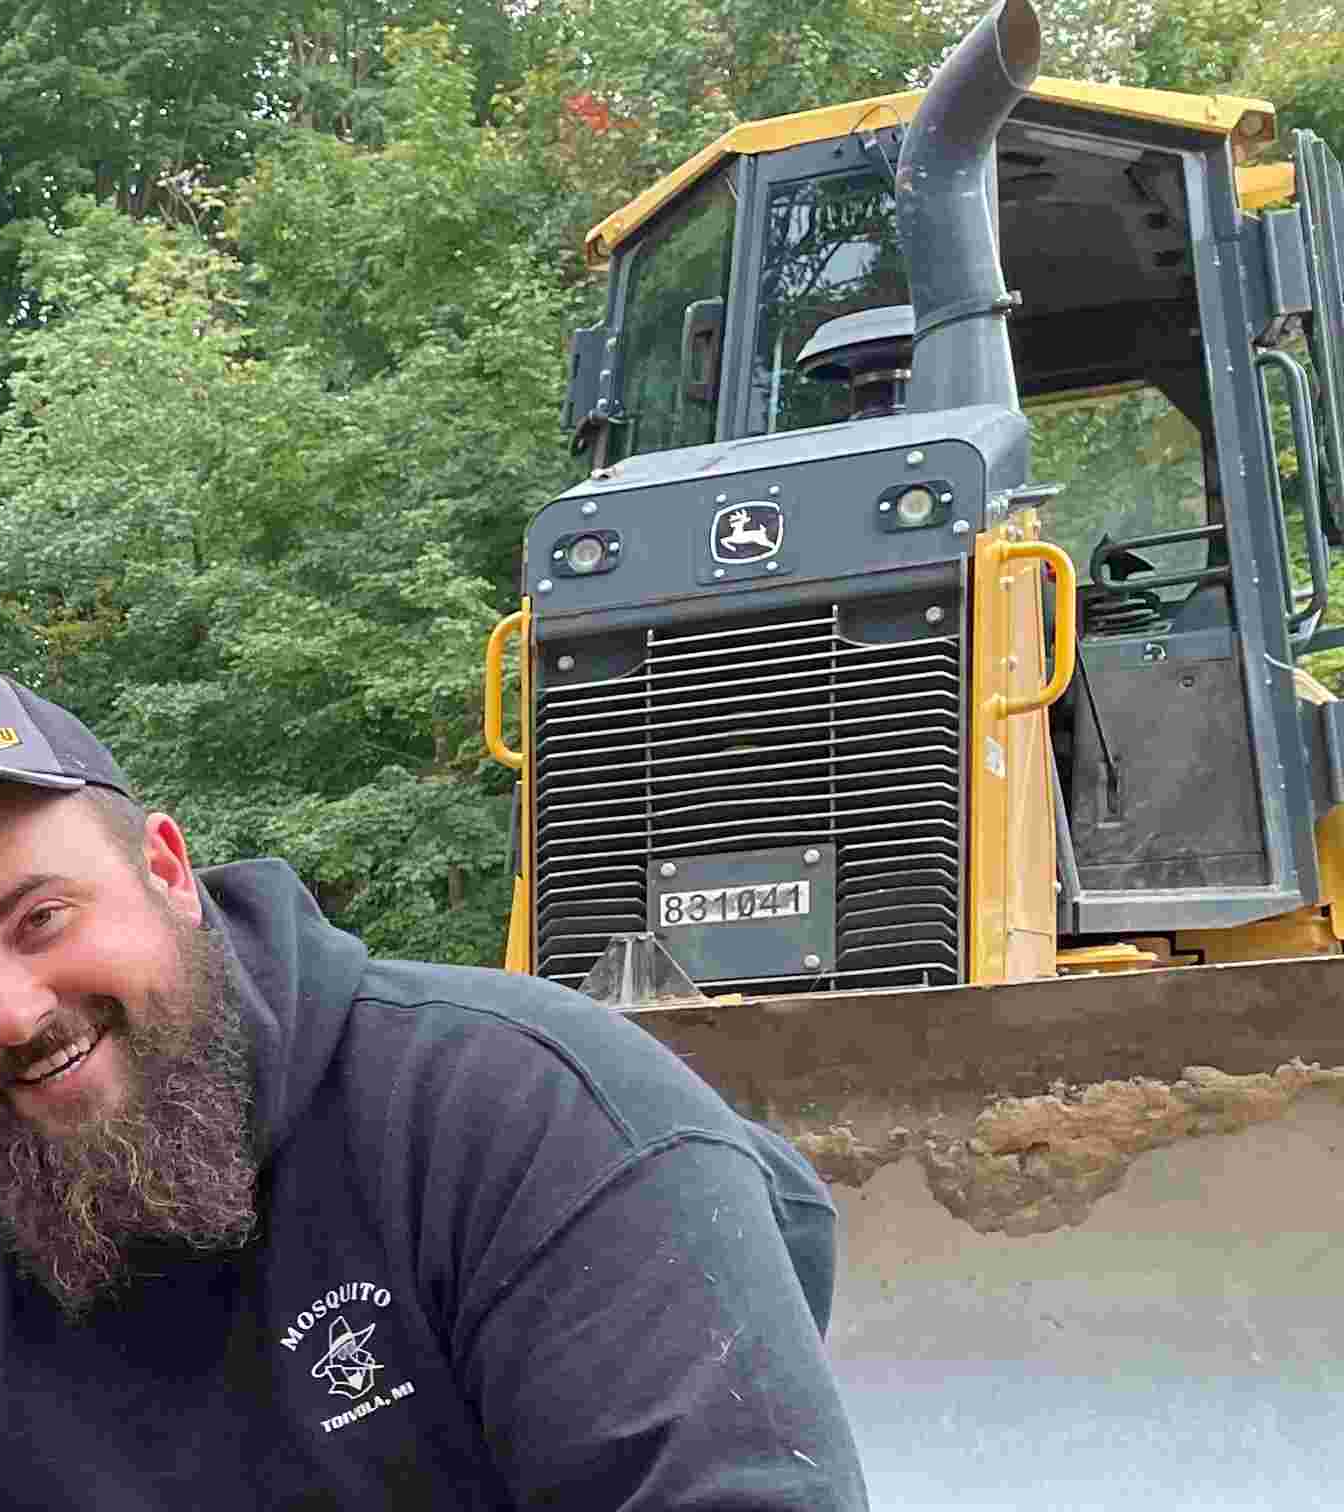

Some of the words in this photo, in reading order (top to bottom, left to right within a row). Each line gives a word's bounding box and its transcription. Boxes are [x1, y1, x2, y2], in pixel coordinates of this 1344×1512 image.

[664, 884, 801, 924] 831041
[280, 1282, 391, 1351] MOSQUITO
[320, 1396, 391, 1432] TOIVOLA,
[391, 1381, 415, 1400] MI
